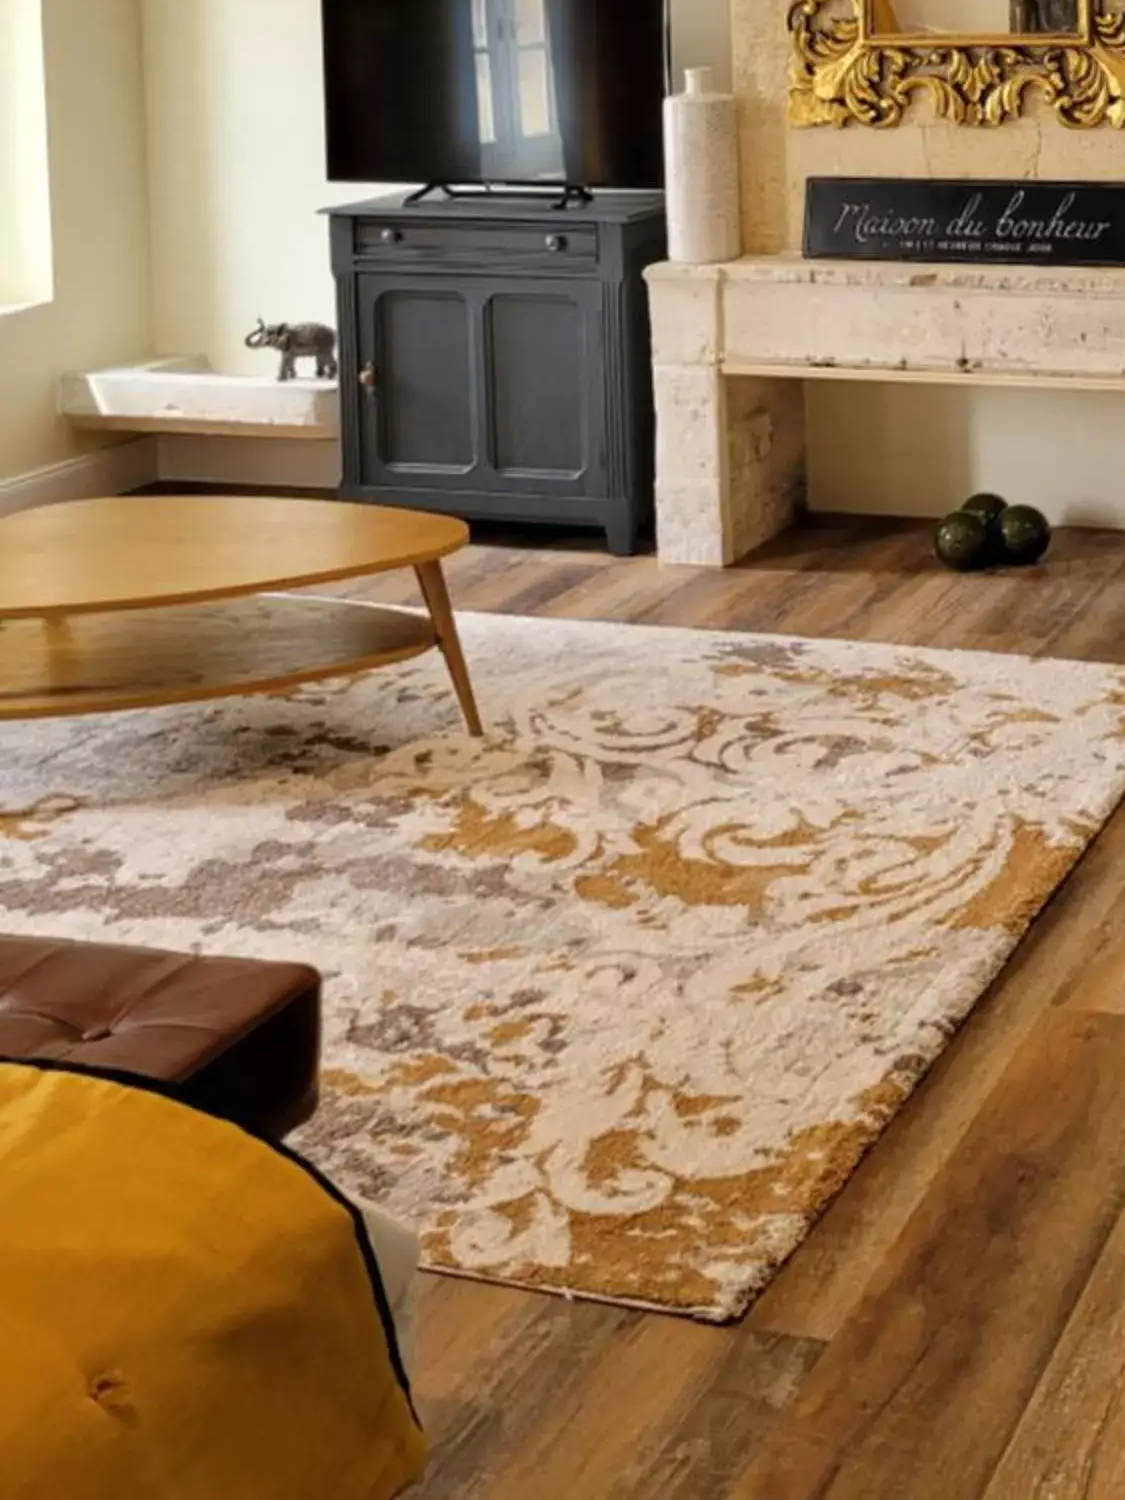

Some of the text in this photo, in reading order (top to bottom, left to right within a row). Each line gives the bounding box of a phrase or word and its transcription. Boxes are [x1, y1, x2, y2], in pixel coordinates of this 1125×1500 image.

[833, 189, 1111, 243] Maison du bonheur
